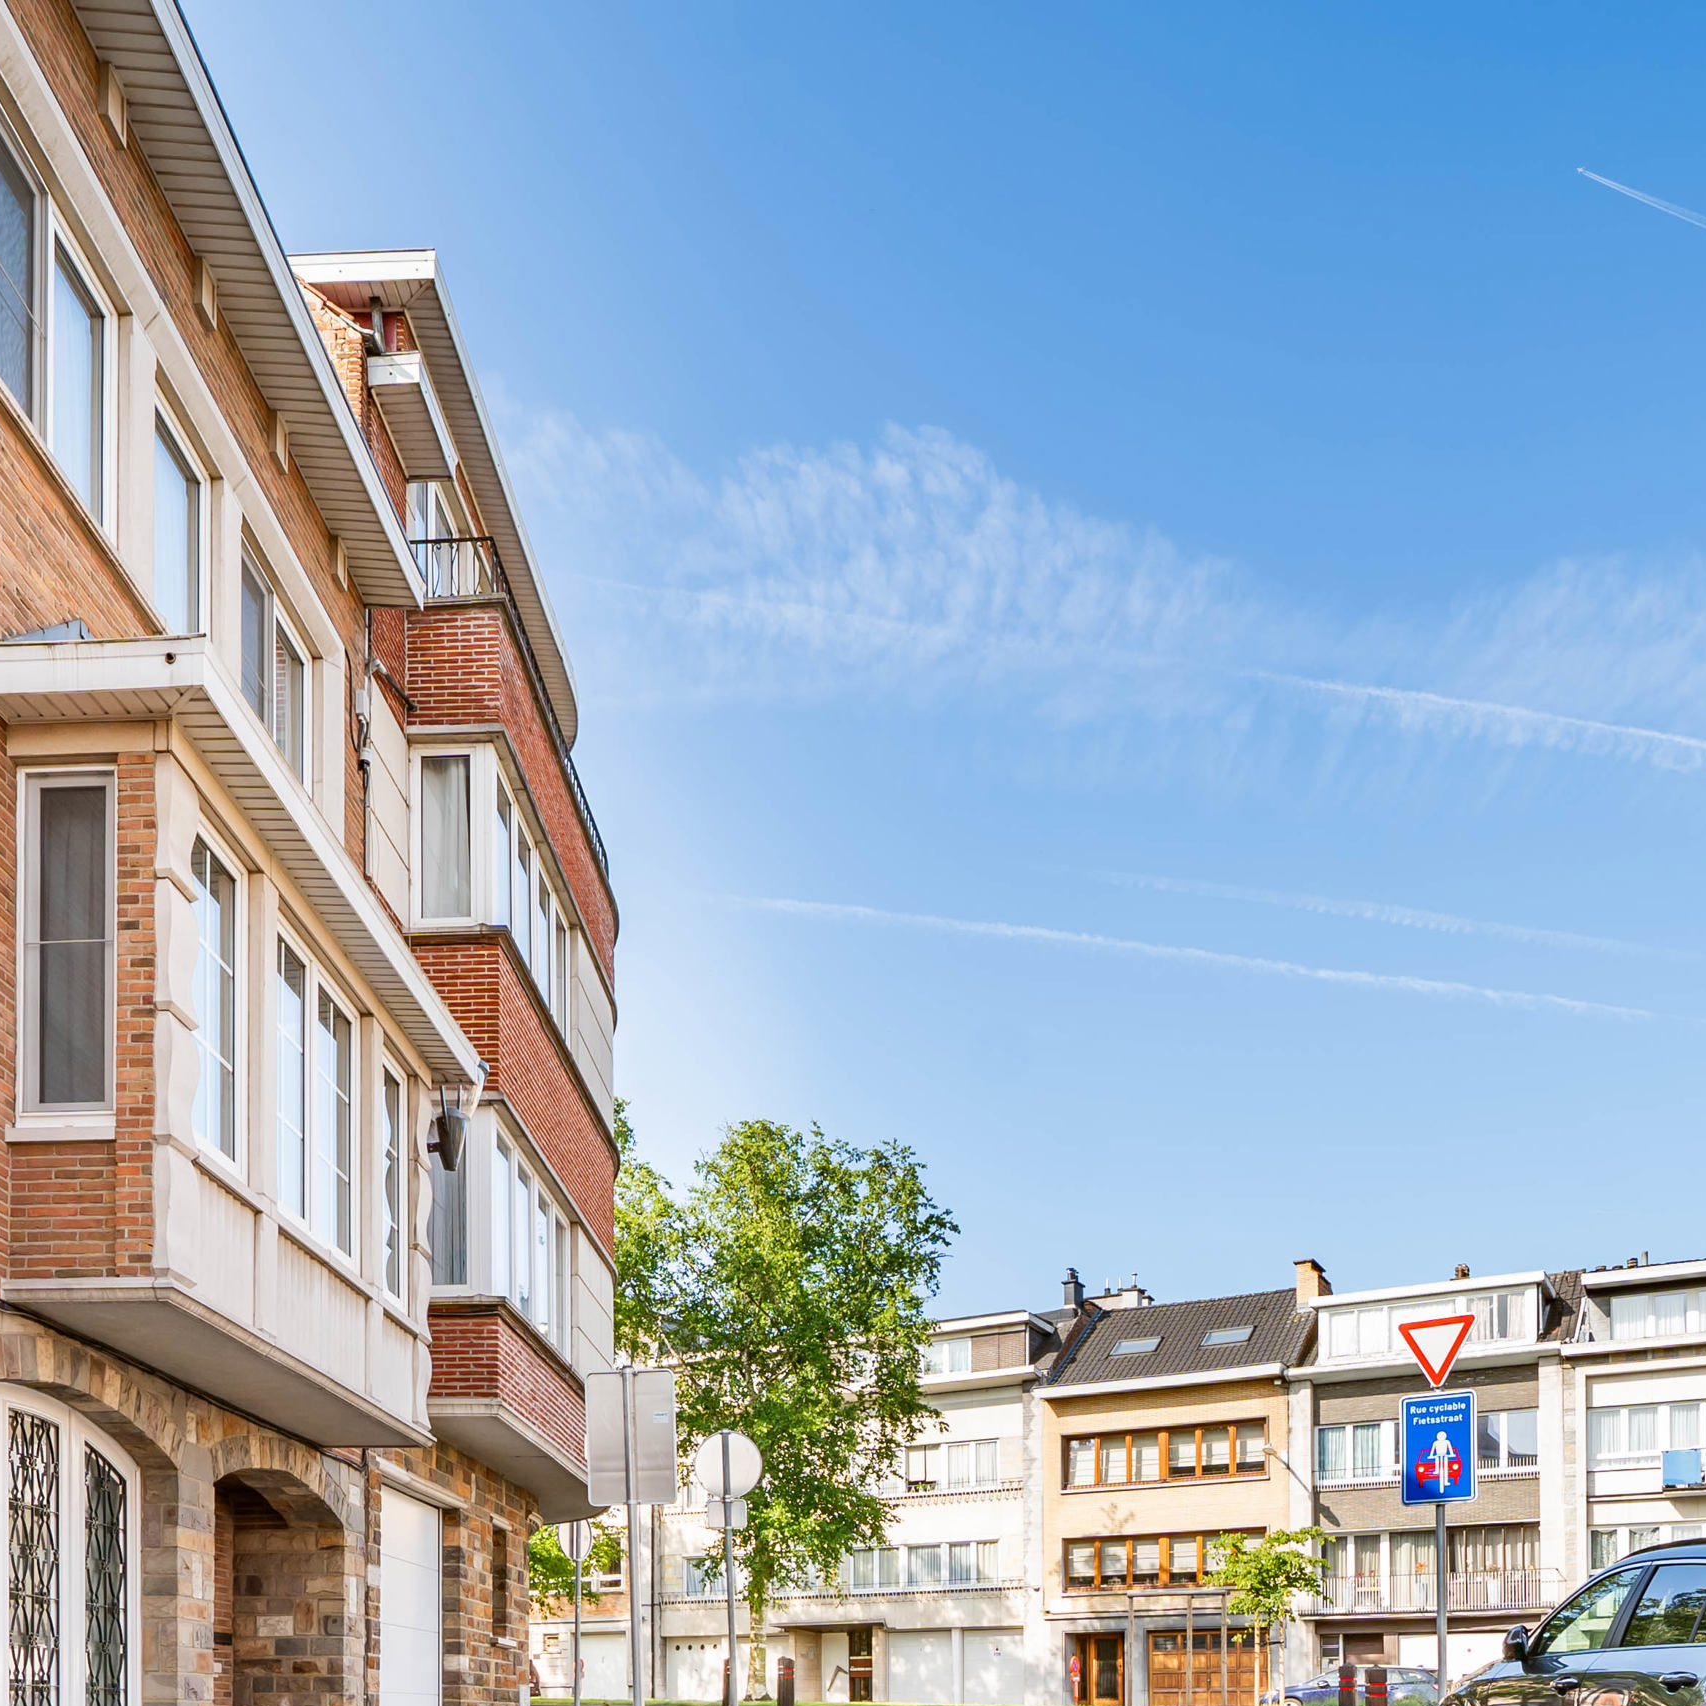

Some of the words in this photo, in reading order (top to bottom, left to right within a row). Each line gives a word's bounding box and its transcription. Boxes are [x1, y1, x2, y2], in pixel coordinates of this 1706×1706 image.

[1410, 1406, 1427, 1415] Rue
[1429, 1402, 1466, 1414] cyclable
[1413, 1414, 1463, 1426] Fietsstraat
